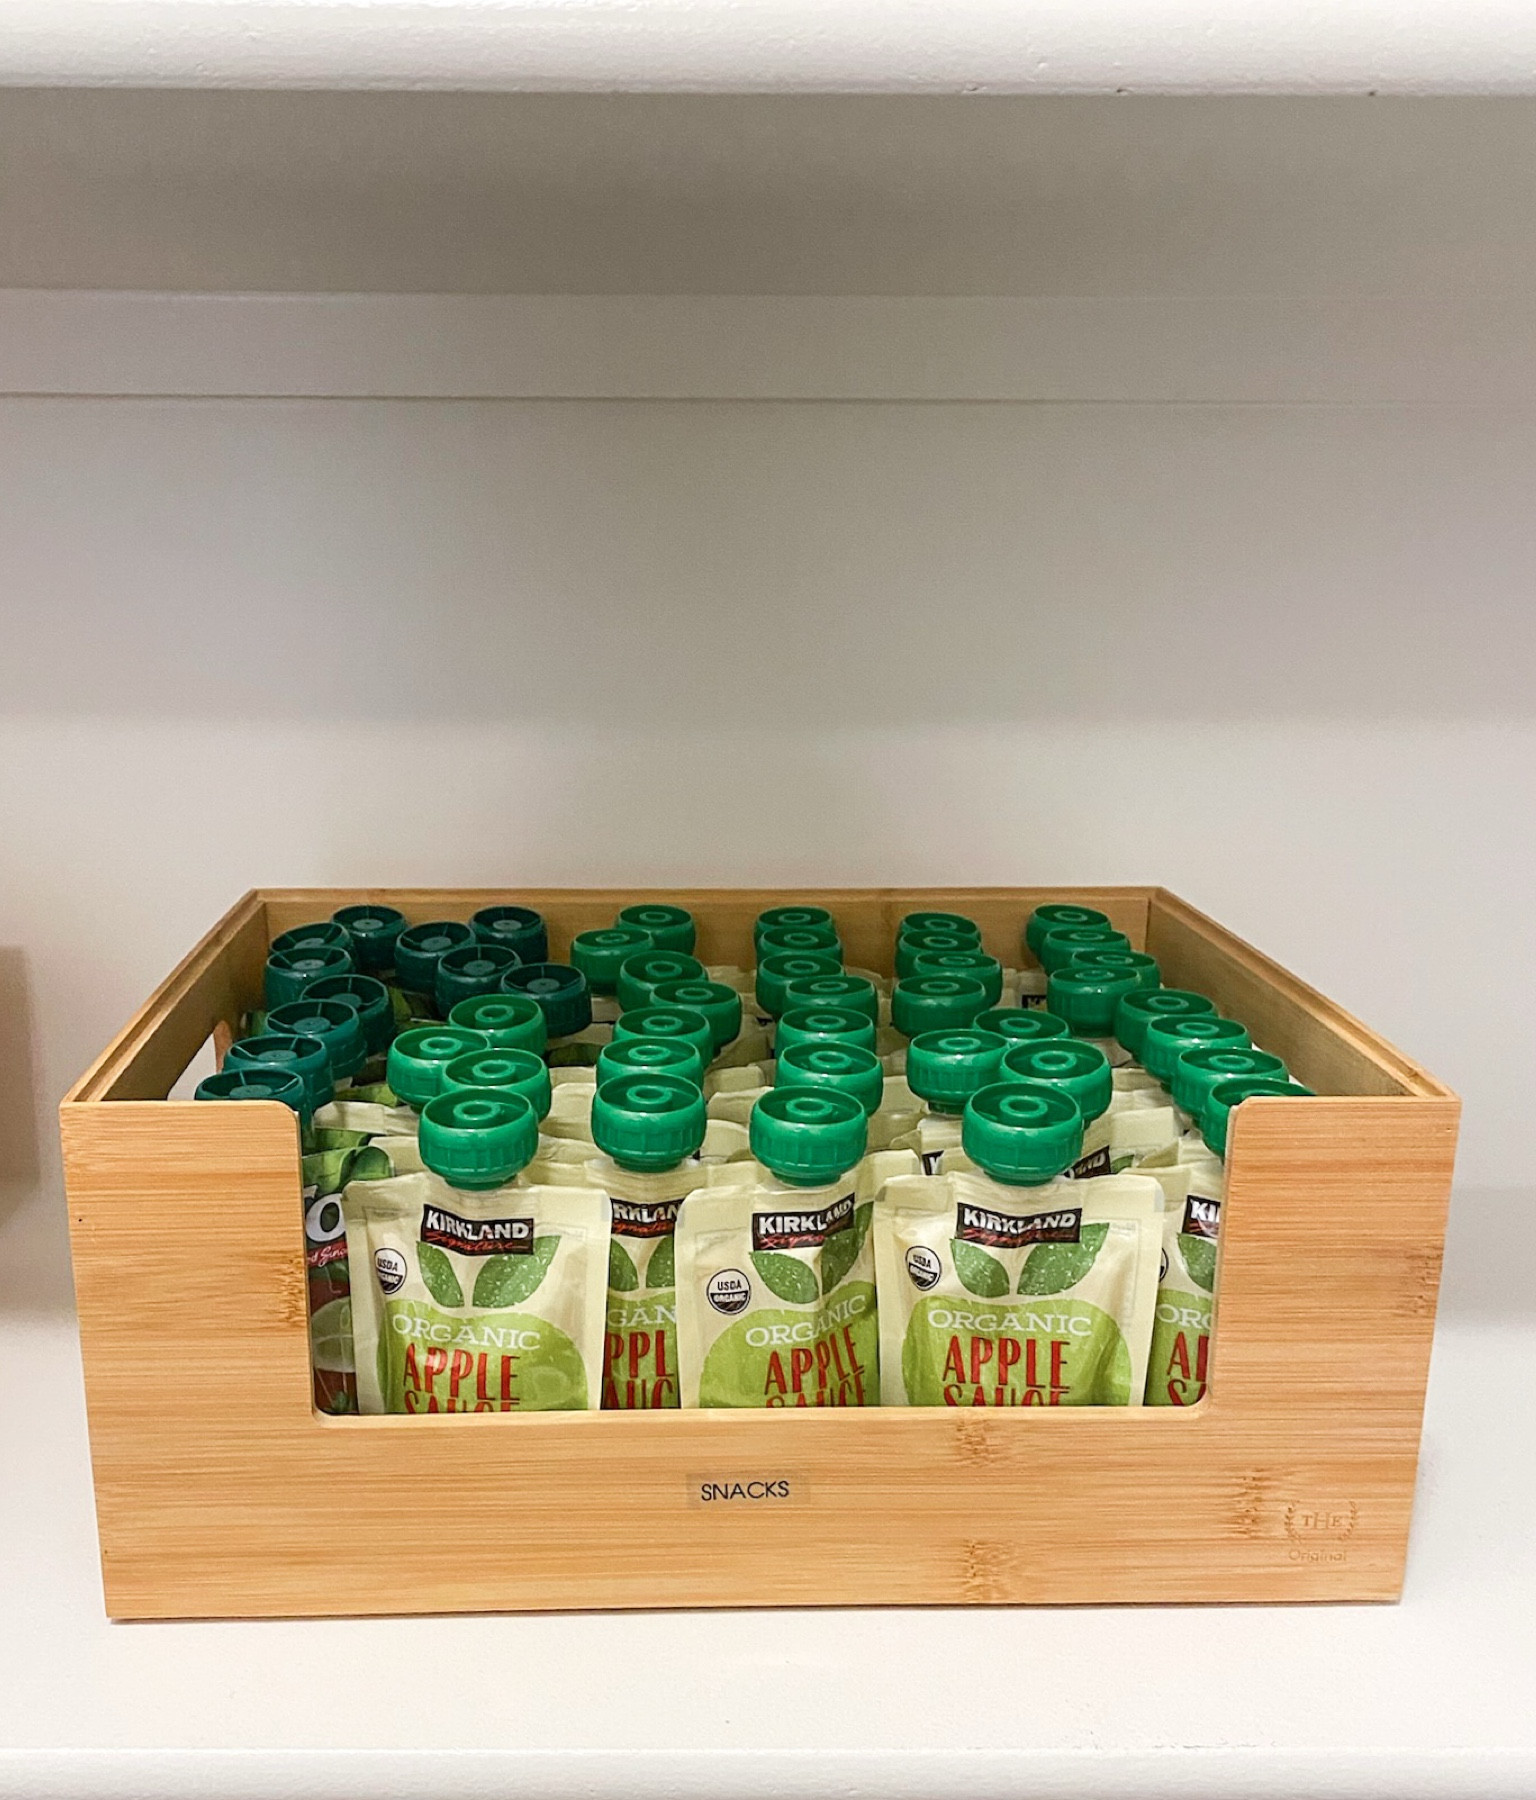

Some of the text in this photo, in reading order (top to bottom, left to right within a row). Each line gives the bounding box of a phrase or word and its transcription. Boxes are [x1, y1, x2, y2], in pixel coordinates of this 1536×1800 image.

[425, 1209, 530, 1242] KIRKLAND
[612, 1202, 681, 1224] RKLAN
[758, 1199, 853, 1235] KIRKLAND
[962, 1207, 1077, 1235] KIRKLAND
[376, 1256, 399, 1273] USDA
[717, 1279, 742, 1291] USDA
[392, 1314, 541, 1350] ORGANIC
[745, 1294, 866, 1347] ORGANIC
[927, 1309, 1092, 1336] ORGANIC
[604, 1330, 675, 1378] PPL
[764, 1323, 865, 1396] APPLE
[942, 1334, 1072, 1390] APPLE
[403, 1342, 521, 1401] APPLE
[701, 1480, 790, 1501] SNACKS
